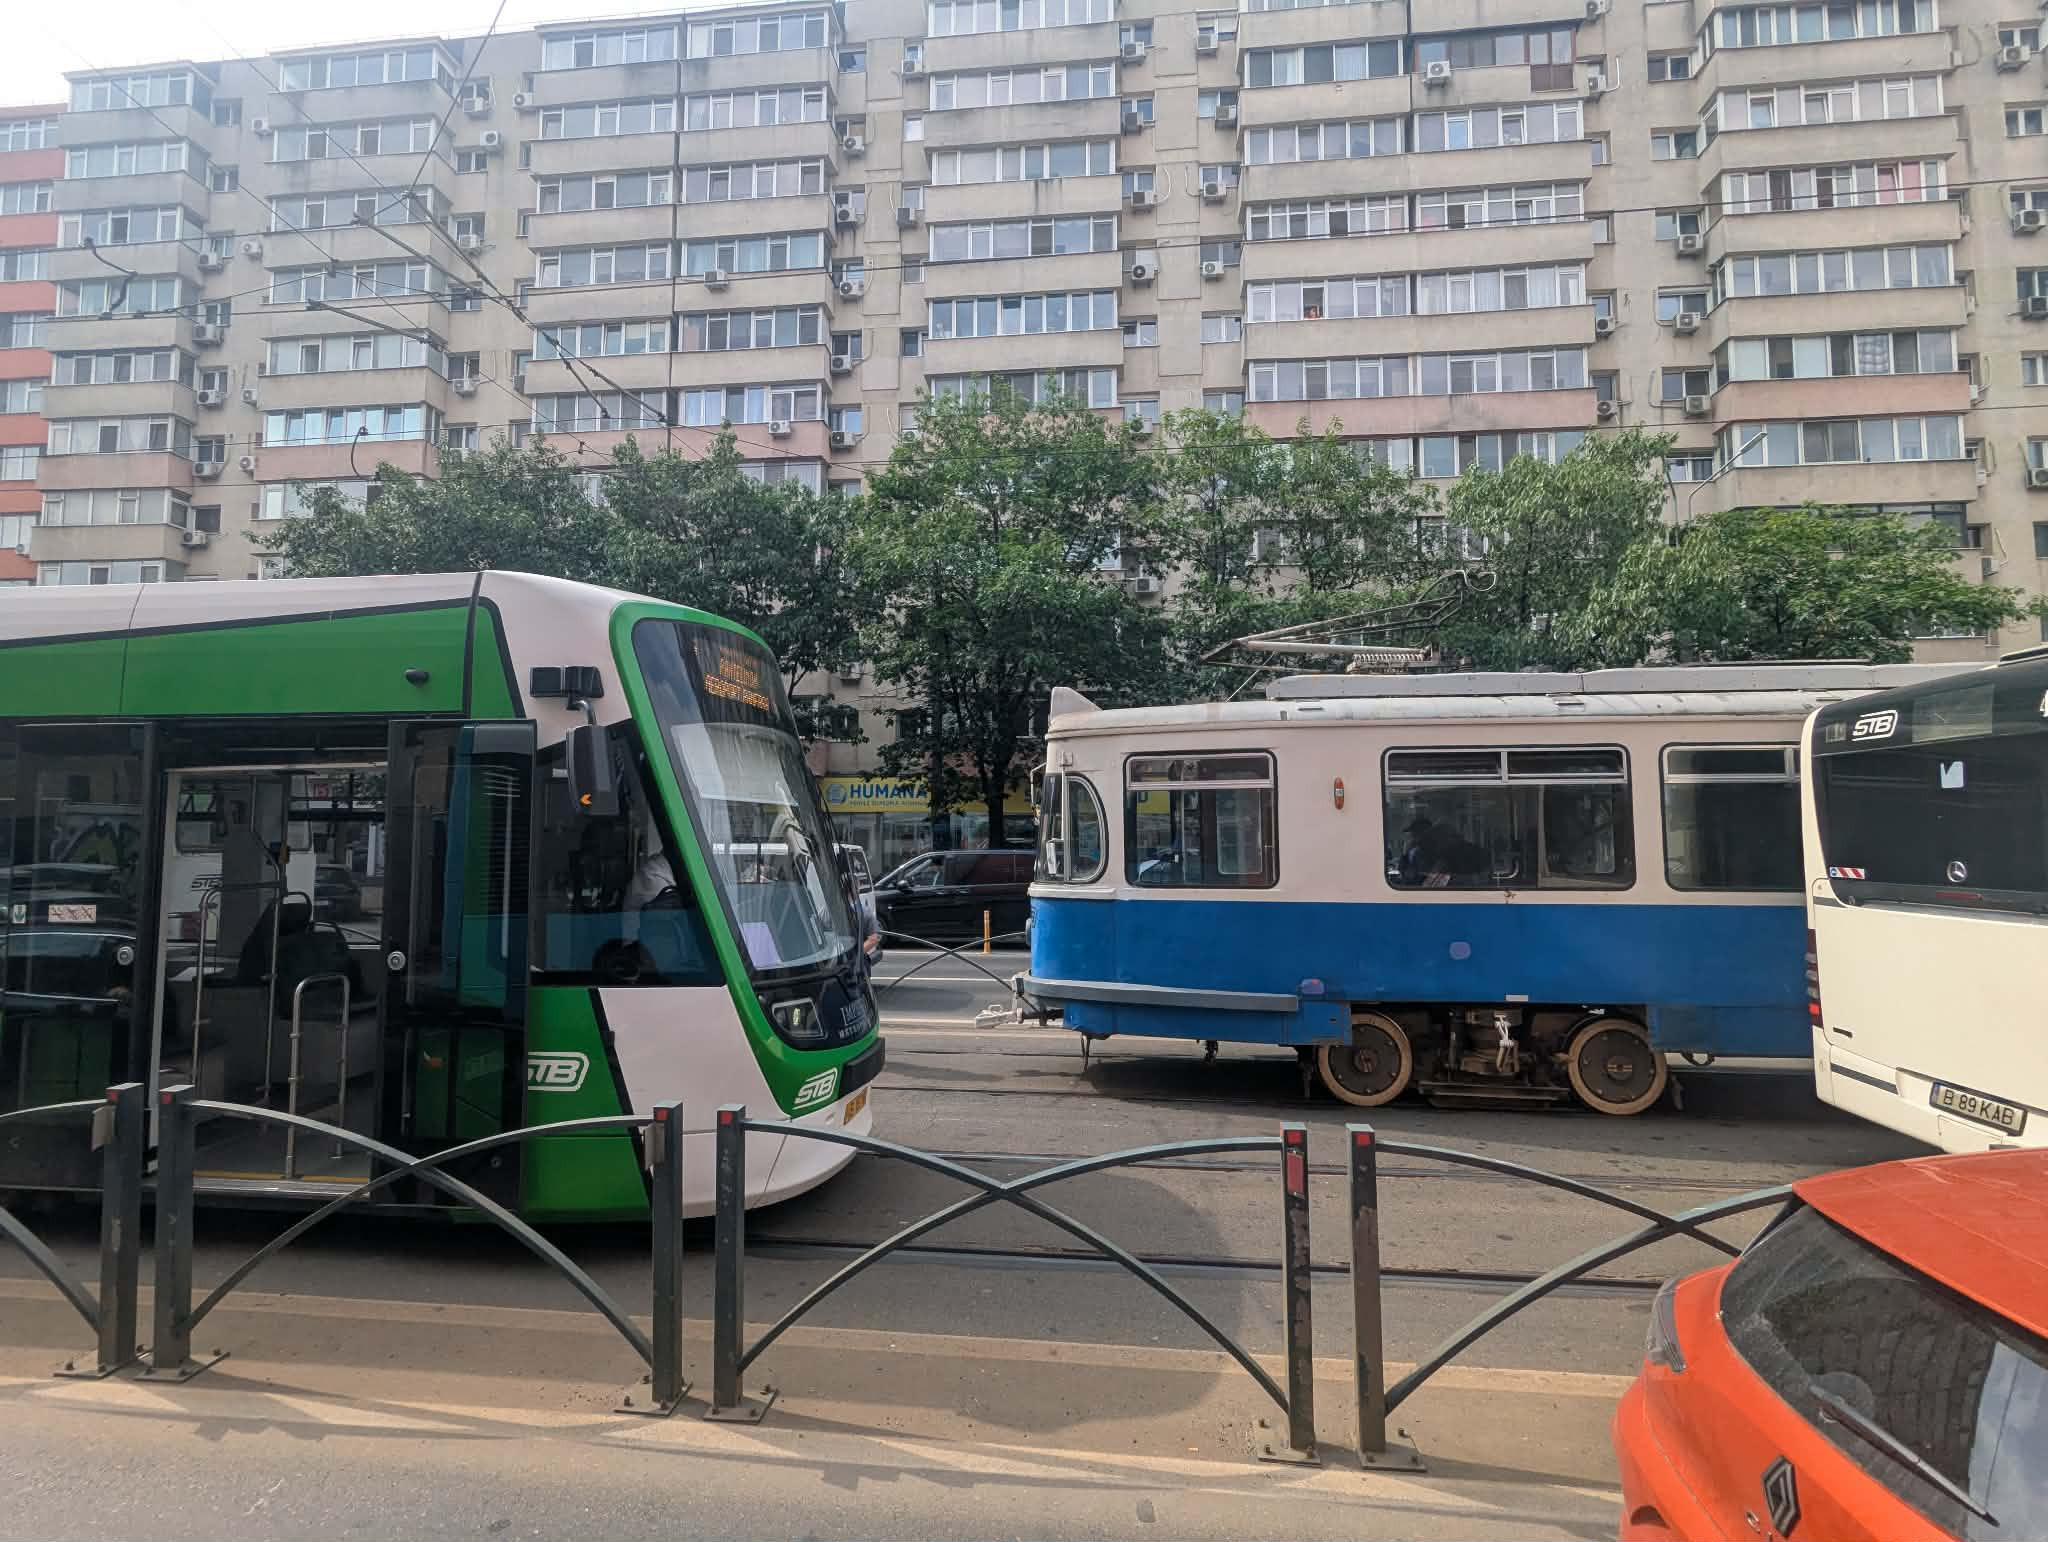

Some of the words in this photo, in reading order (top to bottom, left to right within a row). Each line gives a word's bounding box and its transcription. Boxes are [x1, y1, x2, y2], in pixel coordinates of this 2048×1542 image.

[1852, 714, 1894, 737] STB
[850, 783, 929, 799] HUMANA
[528, 1059, 581, 1084] TB
[794, 1072, 835, 1104] STB
[1943, 1089, 1955, 1106] B
[1959, 1094, 1977, 1113] 89
[1979, 1101, 2015, 1125] KAB
